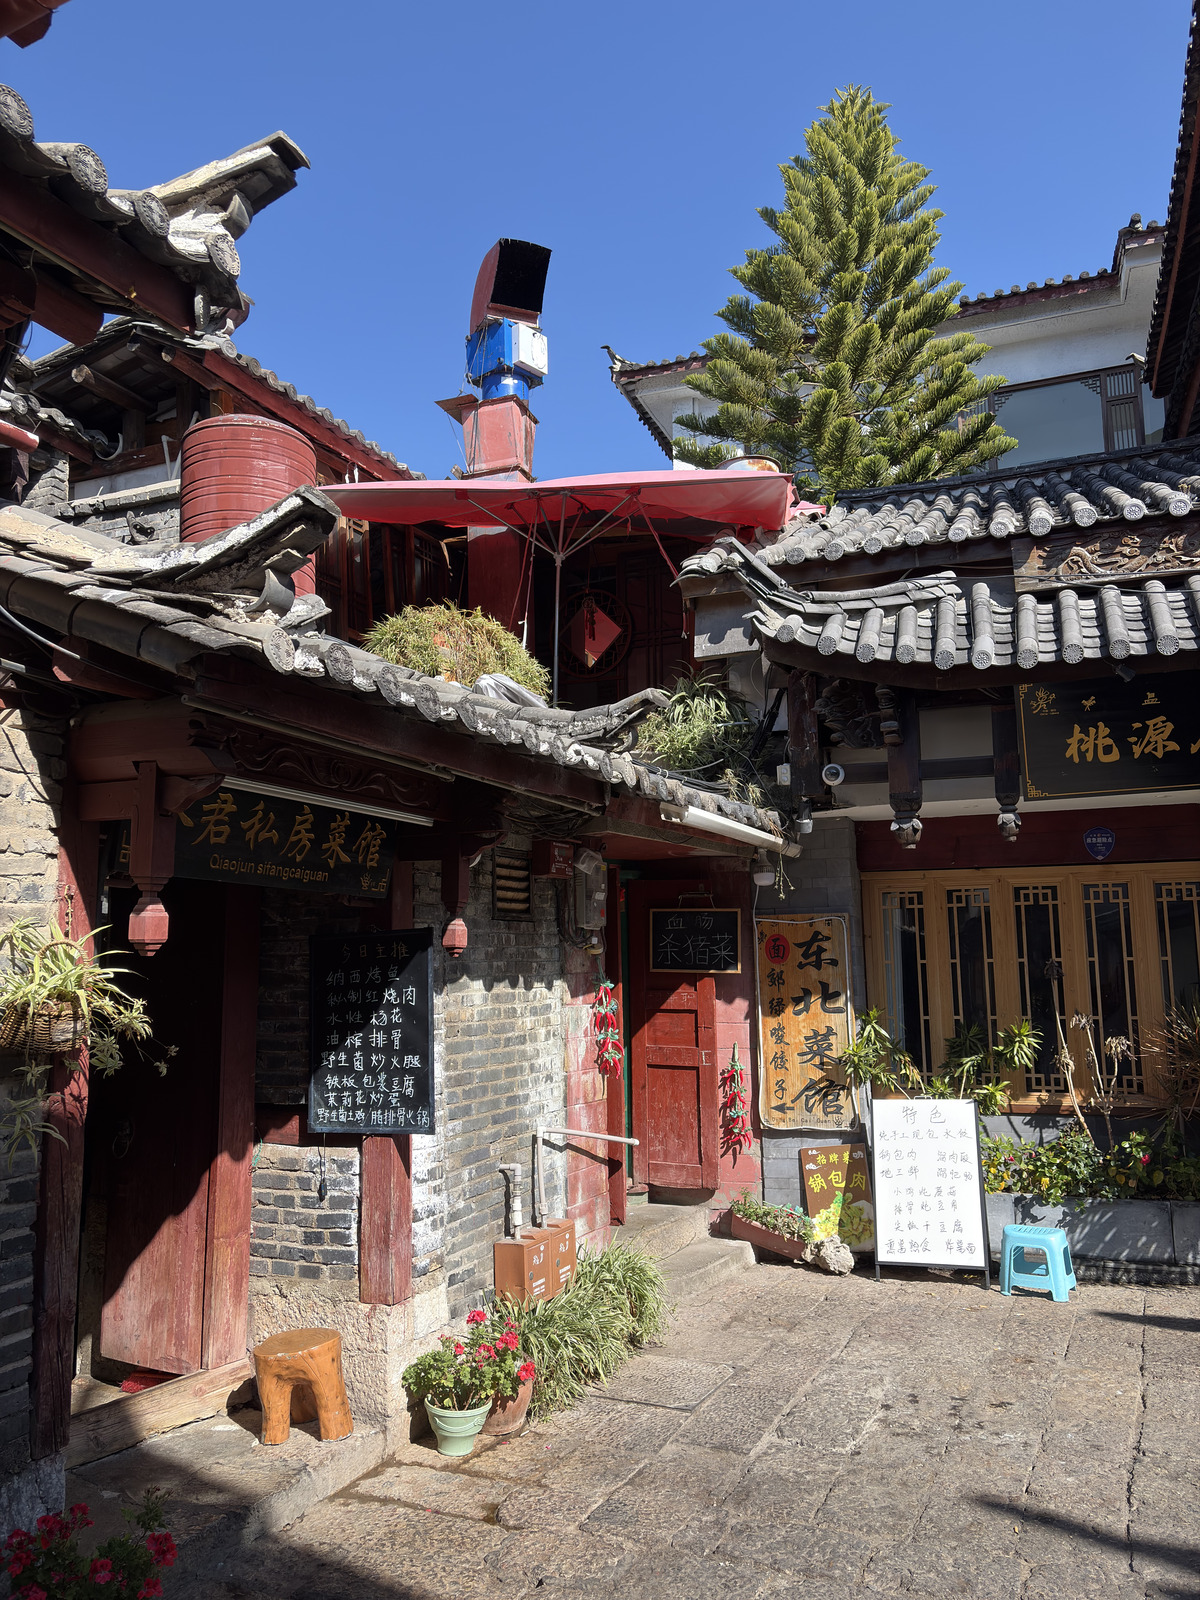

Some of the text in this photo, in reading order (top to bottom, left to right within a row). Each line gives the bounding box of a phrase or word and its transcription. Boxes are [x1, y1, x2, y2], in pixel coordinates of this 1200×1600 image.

[1065, 715, 1200, 764] 桃源
[176, 792, 388, 869] 君私房菜馆
[209, 853, 329, 883] Qiaojun sifangcaiguan
[665, 914, 714, 930] 血肠
[341, 941, 410, 965] 今日主推
[657, 932, 736, 969] 杀猪菜
[325, 964, 400, 987] 纳西烤鱼
[326, 985, 417, 1007] 秘制红烧肉
[326, 1006, 403, 1026] 水性杨花
[790, 930, 850, 1118] 东北菜馆
[320, 1051, 422, 1073] 野生菌炒火腿
[324, 1072, 415, 1098] 铁板包浆豆腐
[324, 1089, 401, 1108] 茉莉花炒蛋
[902, 1104, 946, 1125] 特色
[816, 1151, 853, 1165] 招牌菜
[879, 1148, 917, 1163] 锅包肉
[808, 1170, 866, 1193] 锅包肉
[880, 1165, 919, 1181] 地三鲜
